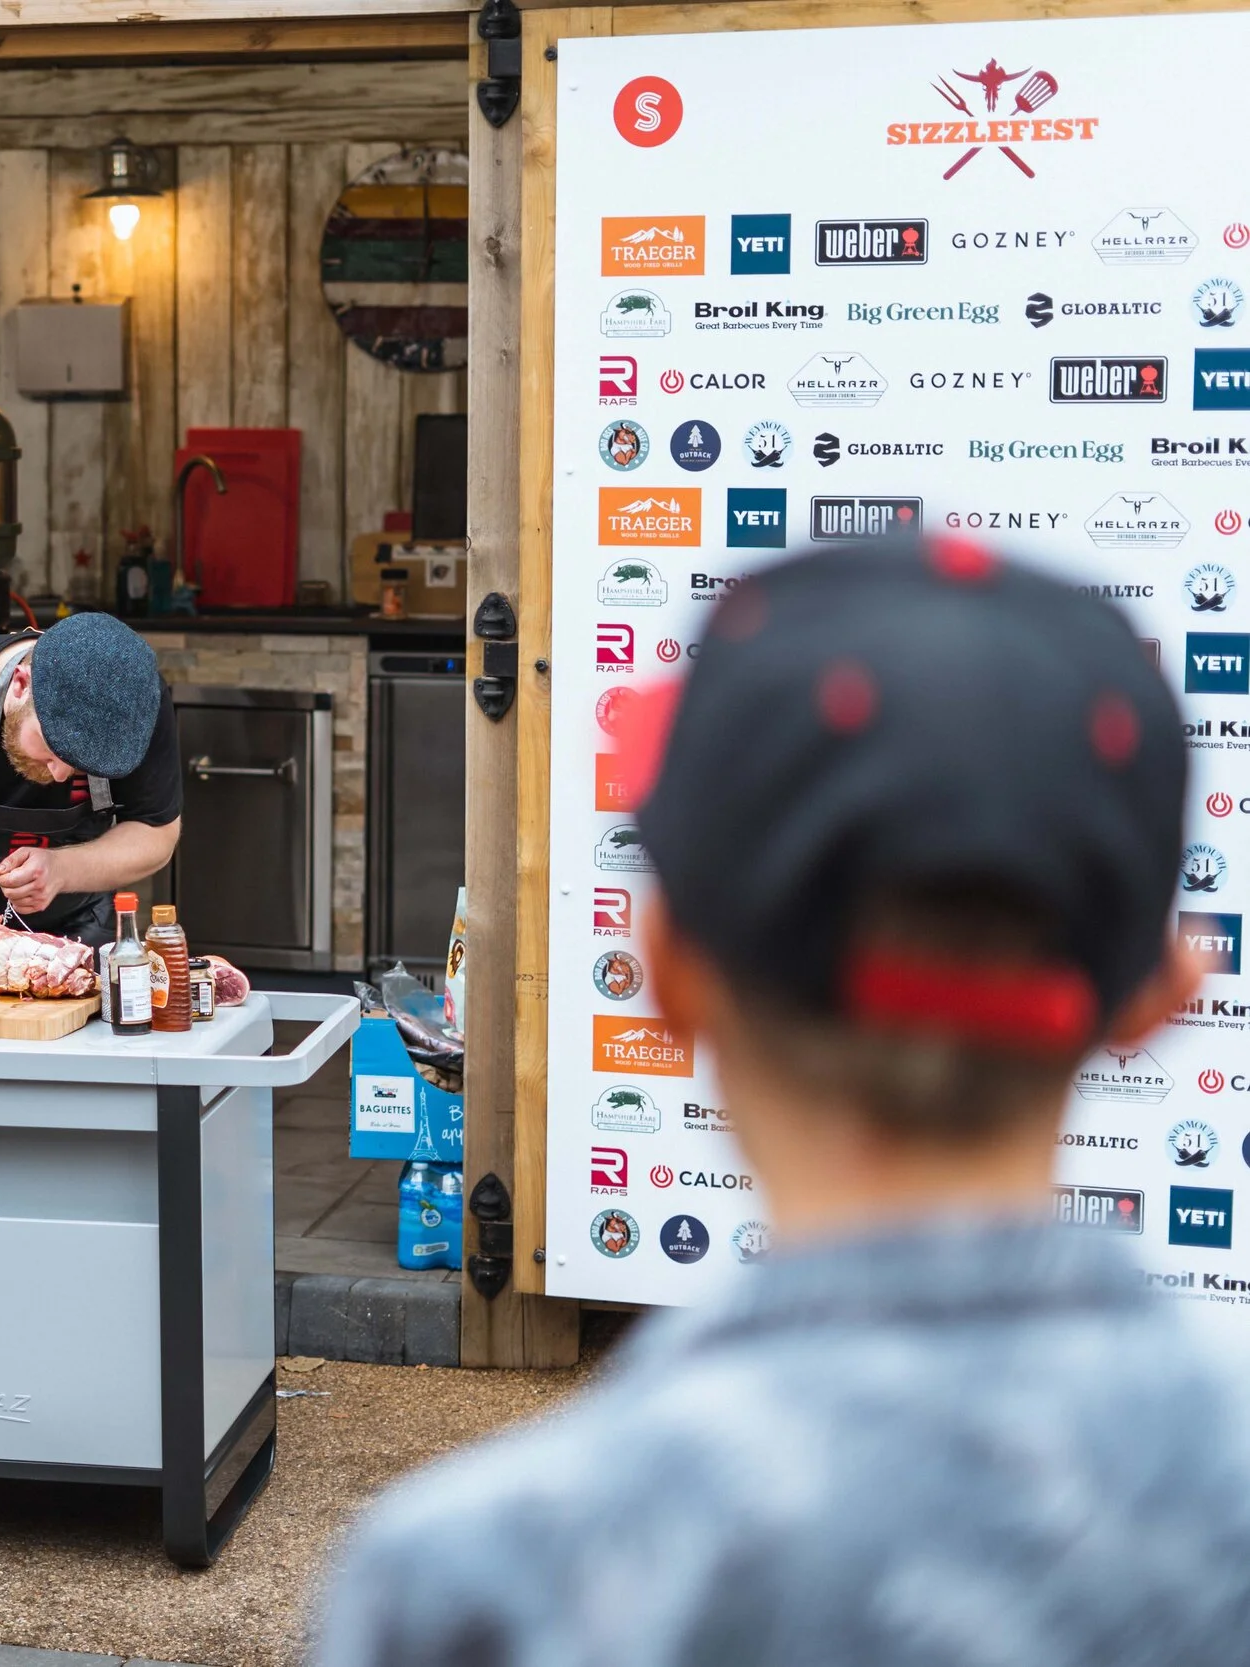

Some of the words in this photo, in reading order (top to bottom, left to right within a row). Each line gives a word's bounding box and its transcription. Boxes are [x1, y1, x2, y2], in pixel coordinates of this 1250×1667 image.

[635, 90, 662, 132] S
[886, 117, 1098, 145] SIZZLEFEST
[737, 236, 784, 253] YETI
[824, 223, 898, 259] weber
[952, 231, 1067, 248] GOZNEY
[1102, 236, 1188, 245] HELLRAZR
[611, 245, 696, 261] TRAEGER
[1193, 279, 1244, 302] WEYMOUTH
[695, 300, 757, 318] Broil
[766, 300, 824, 320] King
[848, 302, 882, 325] Big
[886, 302, 953, 321] Green
[959, 302, 999, 324] Egg
[1061, 302, 1162, 316] GLOBALTIC
[695, 322, 721, 330] Great
[723, 322, 769, 330] Barbecues
[772, 322, 797, 331] Every
[800, 321, 823, 329] Time
[690, 373, 766, 390] CALOR
[910, 372, 1024, 389] GOZNEY
[1060, 360, 1137, 396] weber
[1200, 370, 1250, 389] YETI
[599, 398, 637, 406] RAPS
[745, 421, 791, 444] WEYMOUTH
[848, 443, 943, 455] GLOBALTIC
[968, 440, 1004, 462] Big
[1008, 440, 1078, 459] Green
[1082, 440, 1124, 462] Egg
[1151, 437, 1220, 454] Broil
[608, 516, 692, 533] TRAEGER
[733, 510, 779, 526] YETI
[820, 499, 893, 536] weber
[946, 512, 1060, 529] GOZNEY
[1095, 521, 1180, 529] HELLRAZR
[691, 573, 743, 591] Bro
[1184, 564, 1235, 587] WEYMOUTH
[691, 593, 716, 601] Great
[596, 665, 634, 673] RAPS
[1192, 655, 1242, 672] YETI
[593, 928, 631, 938] RAPS
[1185, 934, 1234, 952] YETI
[1212, 999, 1250, 1017] Kin
[1218, 1020, 1245, 1031] Every
[602, 1043, 685, 1063] TRAEGER
[1080, 1073, 1164, 1085] HELLRAZR
[360, 1104, 411, 1114] BAGUETTES
[684, 1103, 732, 1121] Bro
[684, 1122, 709, 1131] Great
[1168, 1120, 1218, 1146] WEYMOUTH
[1054, 1133, 1138, 1150] LOBALTIC
[679, 1171, 753, 1191] CALOR
[590, 1187, 628, 1197] RAPS
[1176, 1208, 1225, 1227] YETI
[669, 1244, 701, 1253] OUTBACK
[1210, 1293, 1236, 1304] Every
